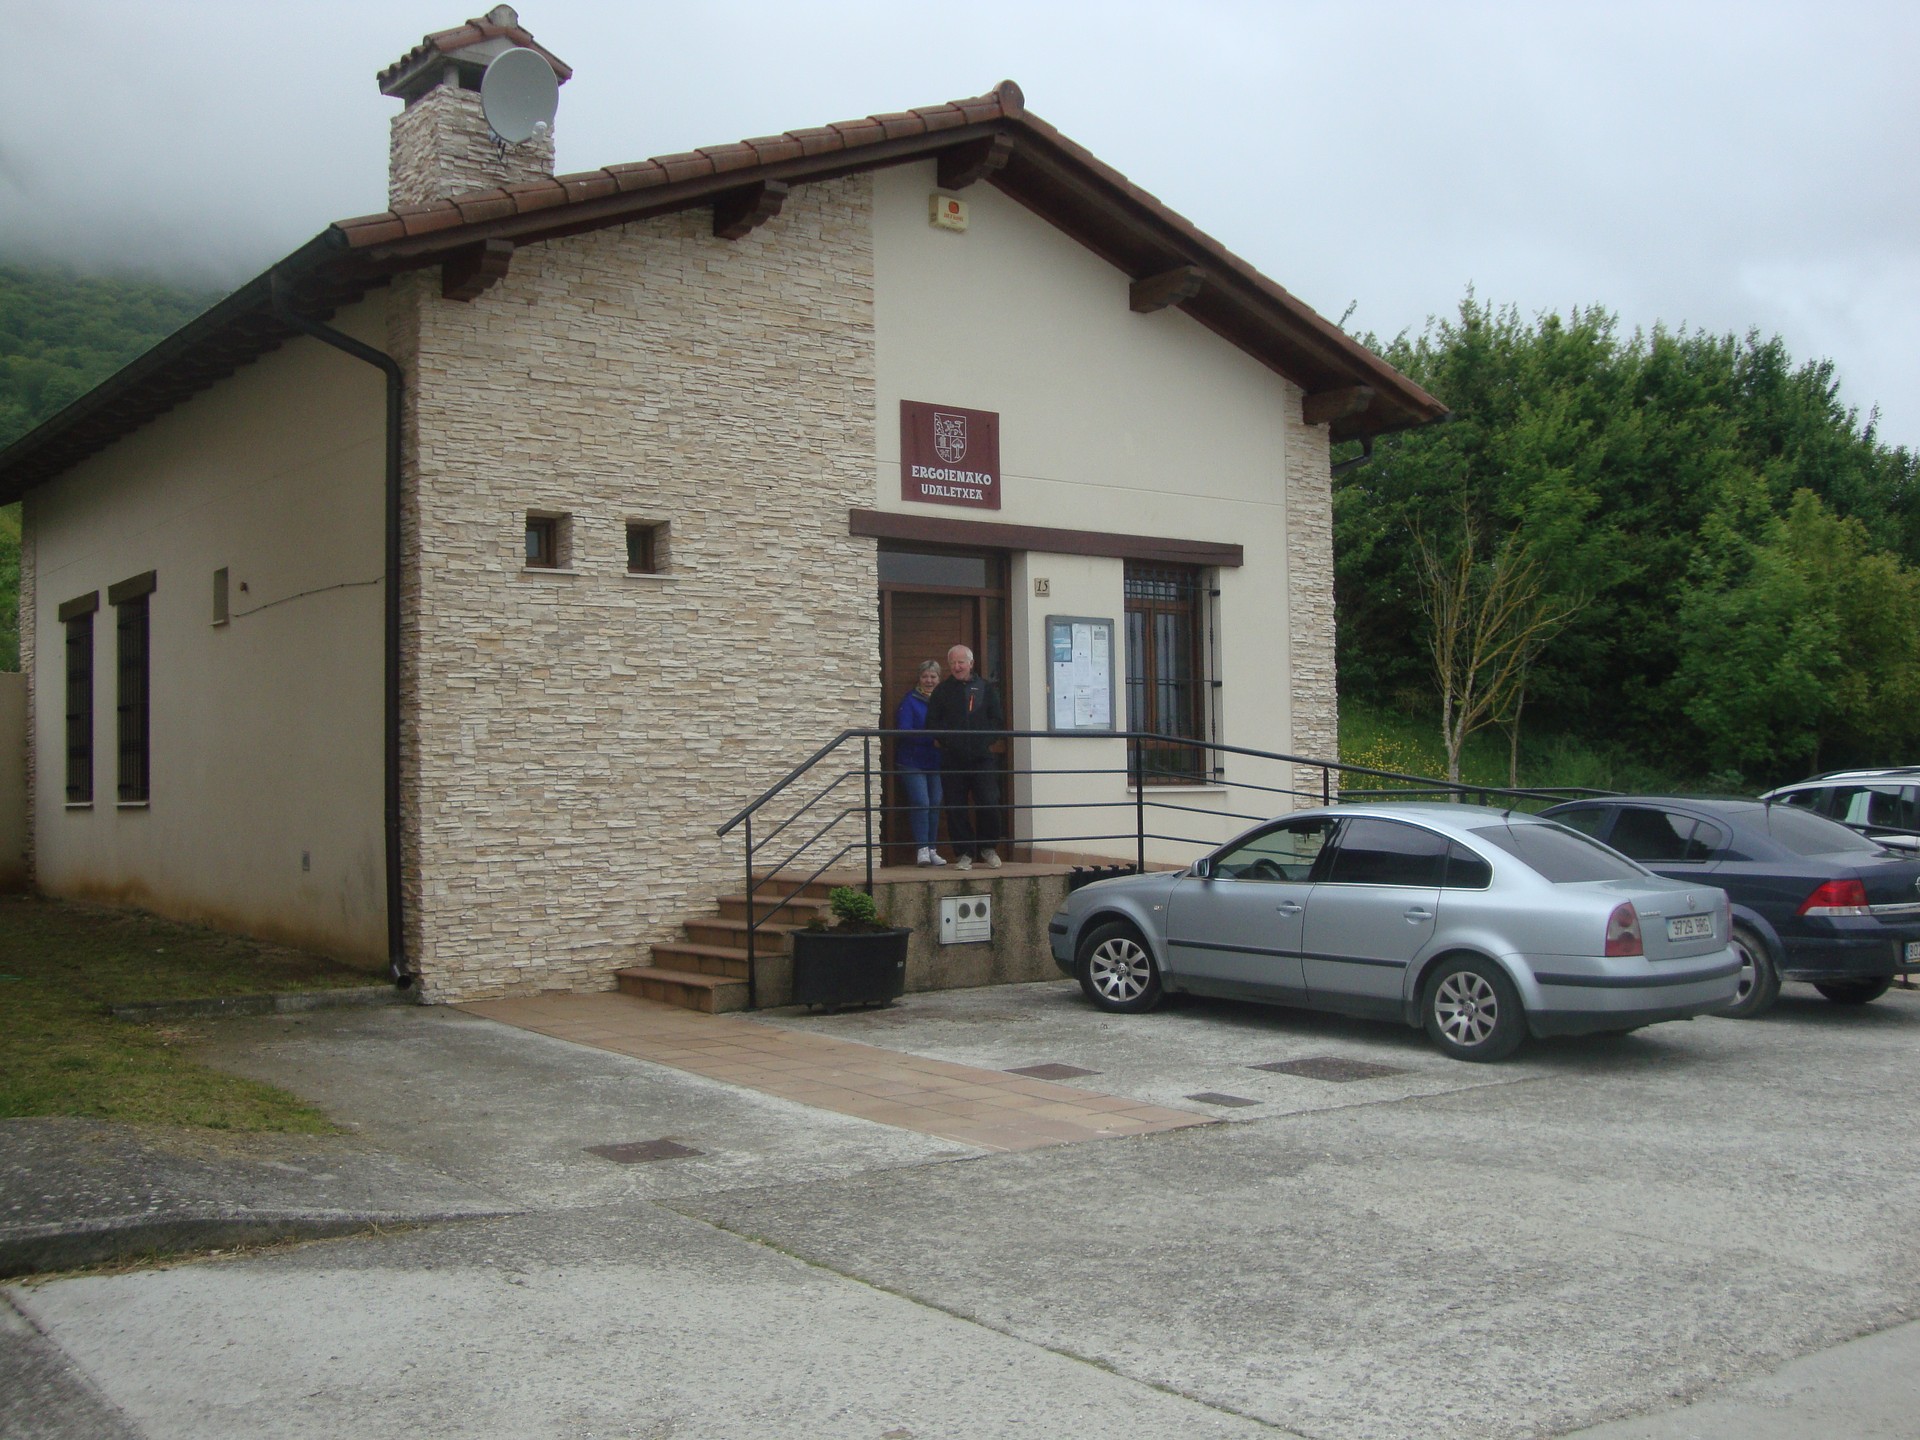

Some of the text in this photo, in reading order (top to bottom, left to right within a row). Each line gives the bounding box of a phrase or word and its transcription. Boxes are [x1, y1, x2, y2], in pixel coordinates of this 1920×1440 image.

[921, 483, 983, 500] UDALETXEA
[1037, 579, 1049, 592] 15
[1672, 919, 1694, 935] 3729
